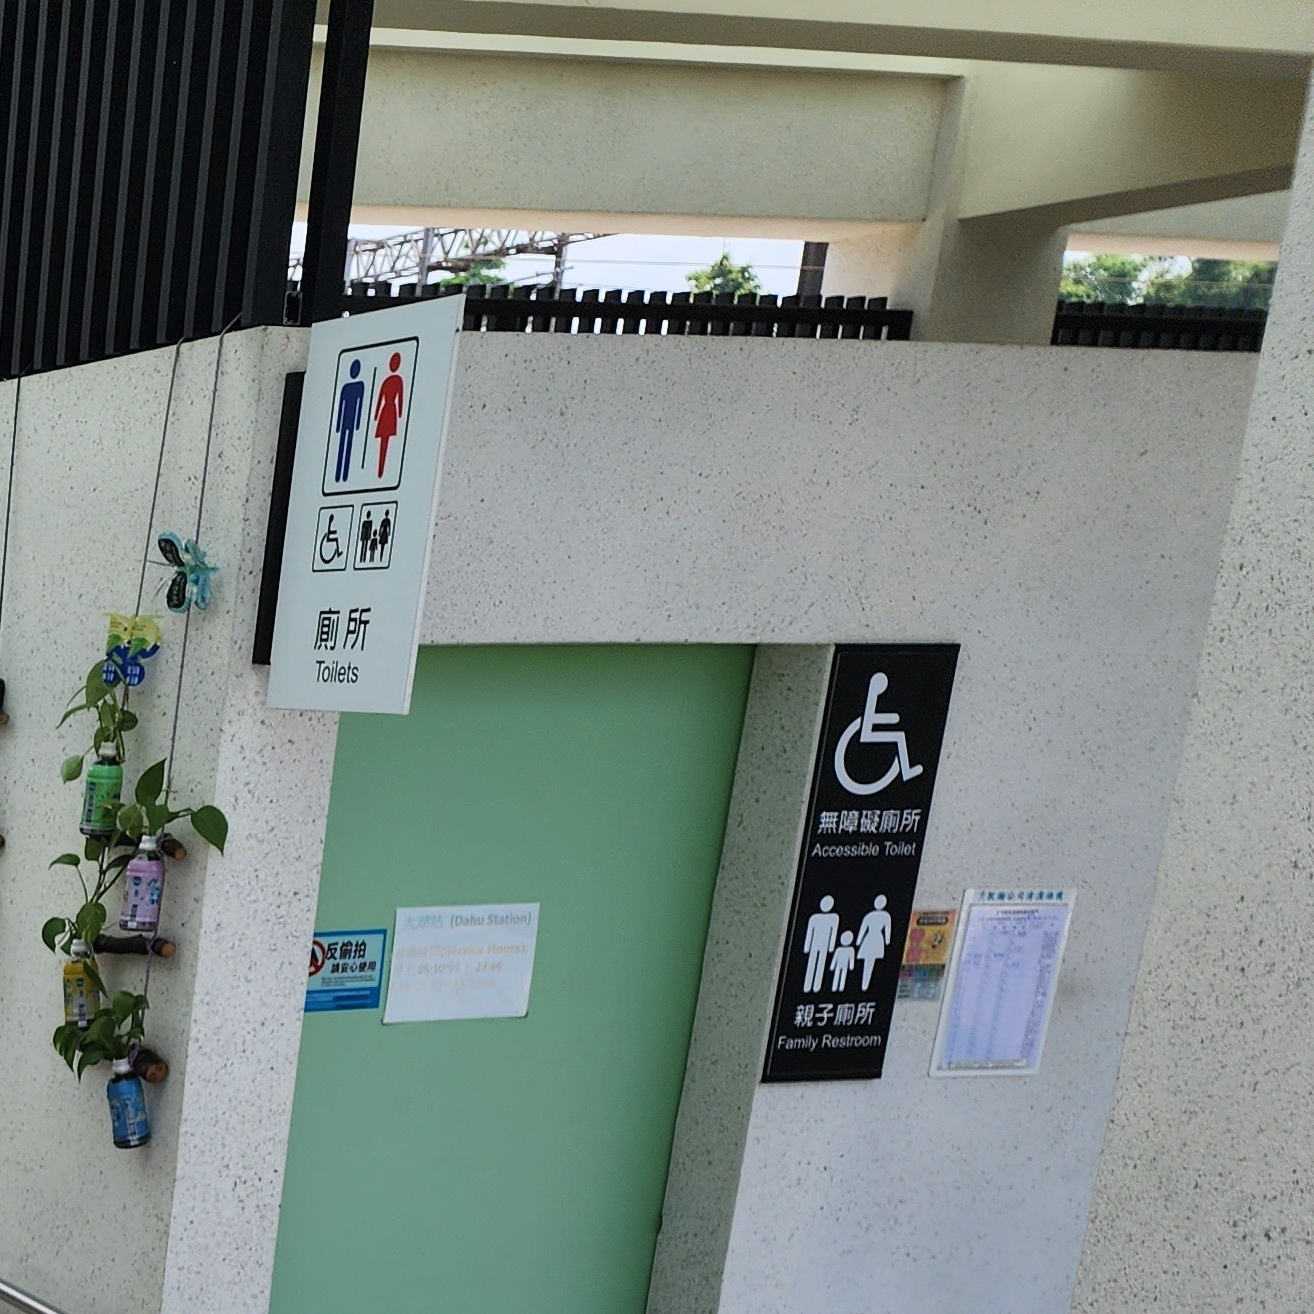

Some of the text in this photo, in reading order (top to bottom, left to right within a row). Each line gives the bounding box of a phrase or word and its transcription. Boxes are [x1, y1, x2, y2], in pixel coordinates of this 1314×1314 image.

[313, 606, 372, 652] 廁所
[315, 660, 360, 684] Toilets
[817, 808, 923, 835] 無障礙廁所
[811, 840, 917, 858] Accessible Toilet
[450, 913, 485, 929] (Dahu
[487, 911, 532, 926] Station)
[325, 939, 367, 961] 反偷拍
[330, 960, 377, 974] 請安心使用
[793, 1001, 877, 1028] 親子廁所
[777, 1033, 882, 1052] Family Restroom
